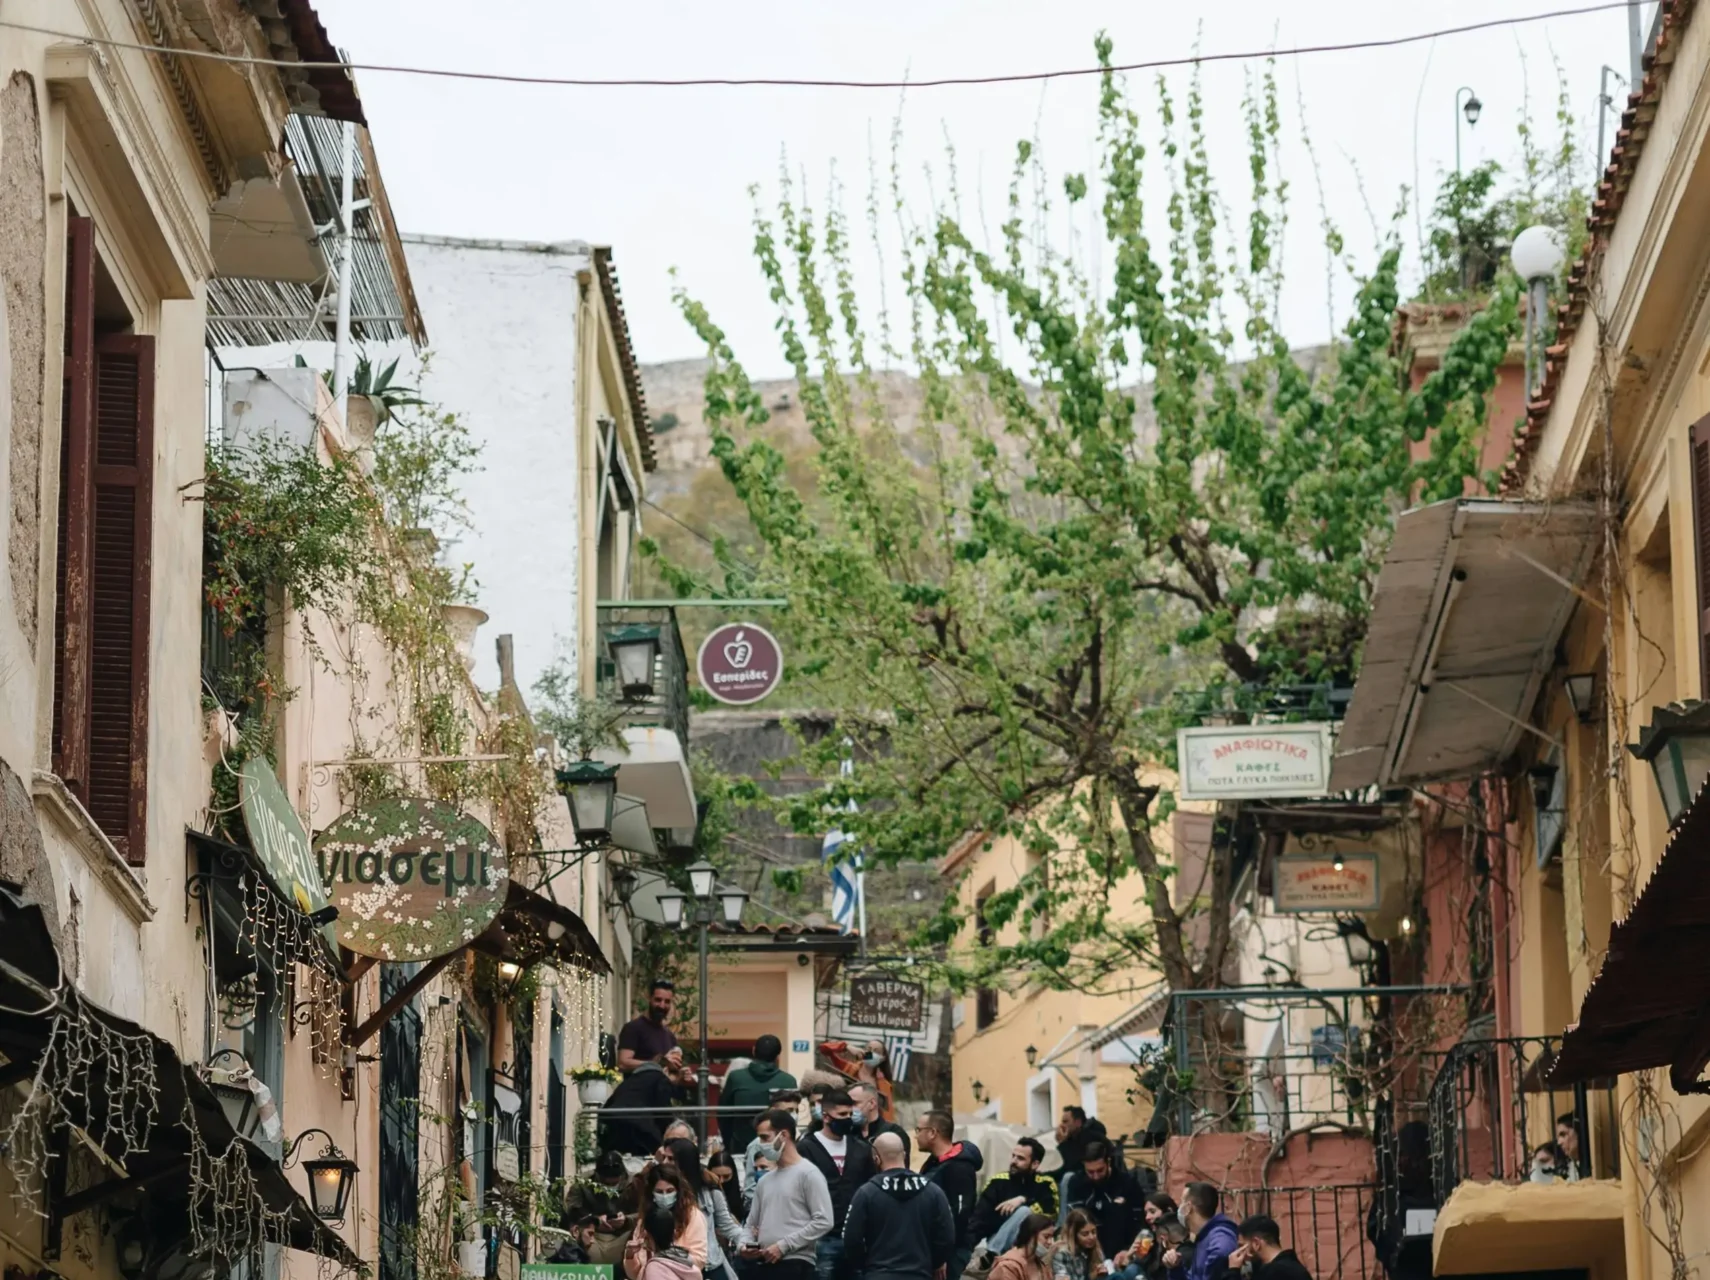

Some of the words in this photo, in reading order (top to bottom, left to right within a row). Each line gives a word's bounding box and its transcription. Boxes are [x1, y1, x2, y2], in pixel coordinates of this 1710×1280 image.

[1212, 739, 1308, 760] ΑΝΑΦΙΩΤΙΚΑ
[857, 982, 919, 999] ΤΑΒΕΡΝΑ
[795, 1042, 807, 1052] 27
